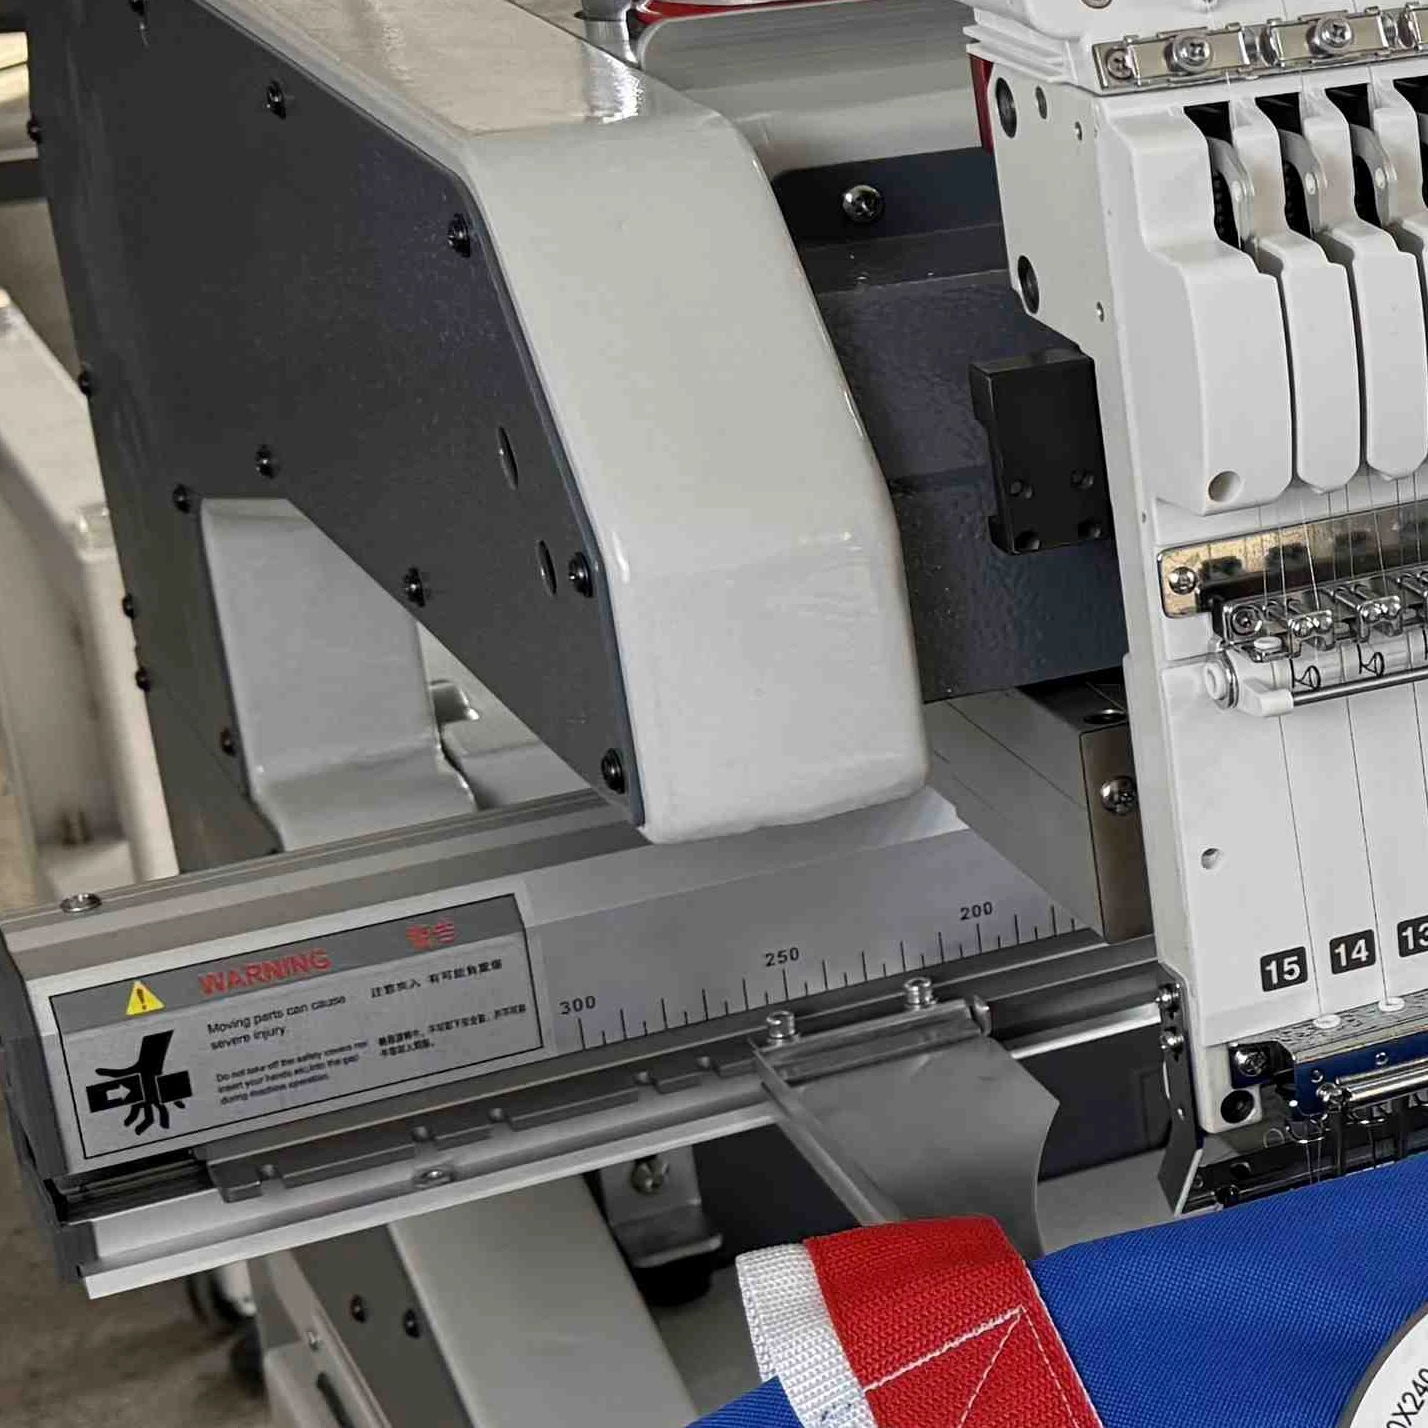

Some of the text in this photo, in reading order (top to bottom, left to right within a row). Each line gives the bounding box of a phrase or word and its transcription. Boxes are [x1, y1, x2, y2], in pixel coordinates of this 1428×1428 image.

[199, 948, 332, 996] WARNING
[559, 901, 993, 1015] 300 250 200
[1265, 956, 1301, 985] 15
[1334, 940, 1369, 967] 14
[208, 995, 346, 1035] Moving parts can cause
